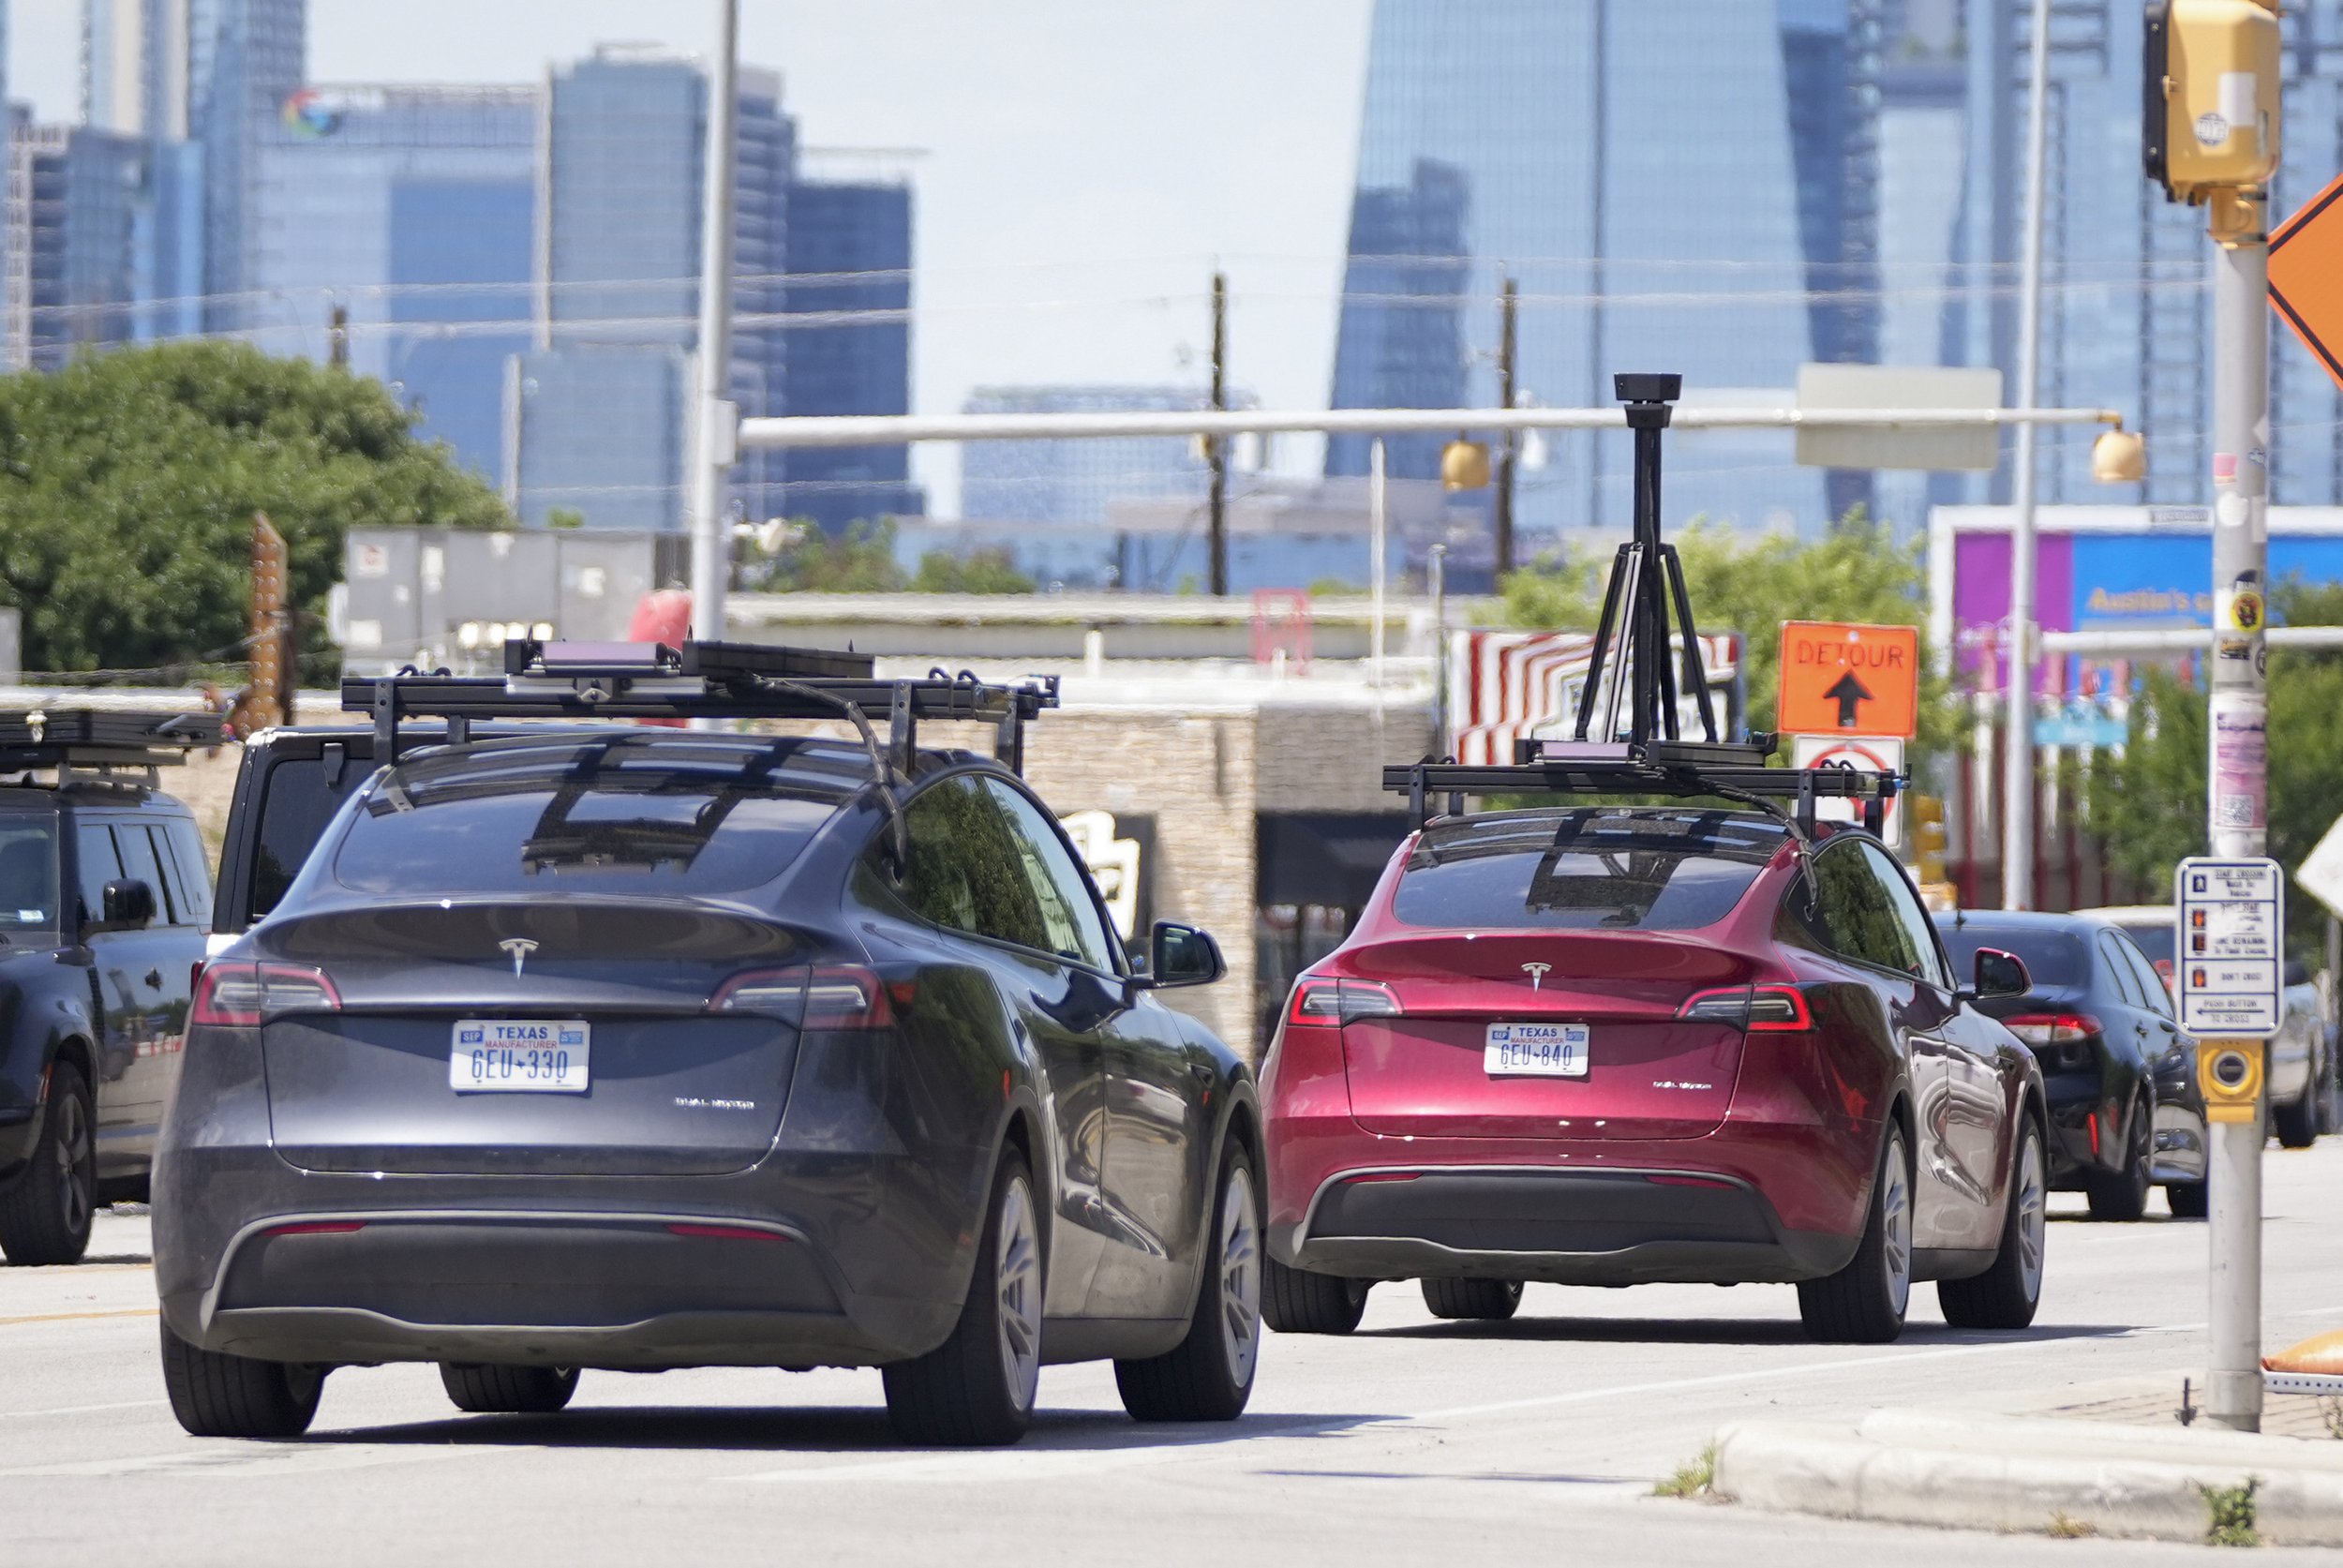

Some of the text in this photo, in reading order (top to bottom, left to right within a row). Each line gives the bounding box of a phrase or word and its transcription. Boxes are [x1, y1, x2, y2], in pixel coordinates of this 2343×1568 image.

[1798, 640, 1903, 668] DETOUR
[463, 1032, 481, 1041] SEP
[496, 1026, 548, 1039] TEXAS
[1518, 1027, 1558, 1037] TEXAS
[485, 1040, 558, 1049] MANUFACTURER
